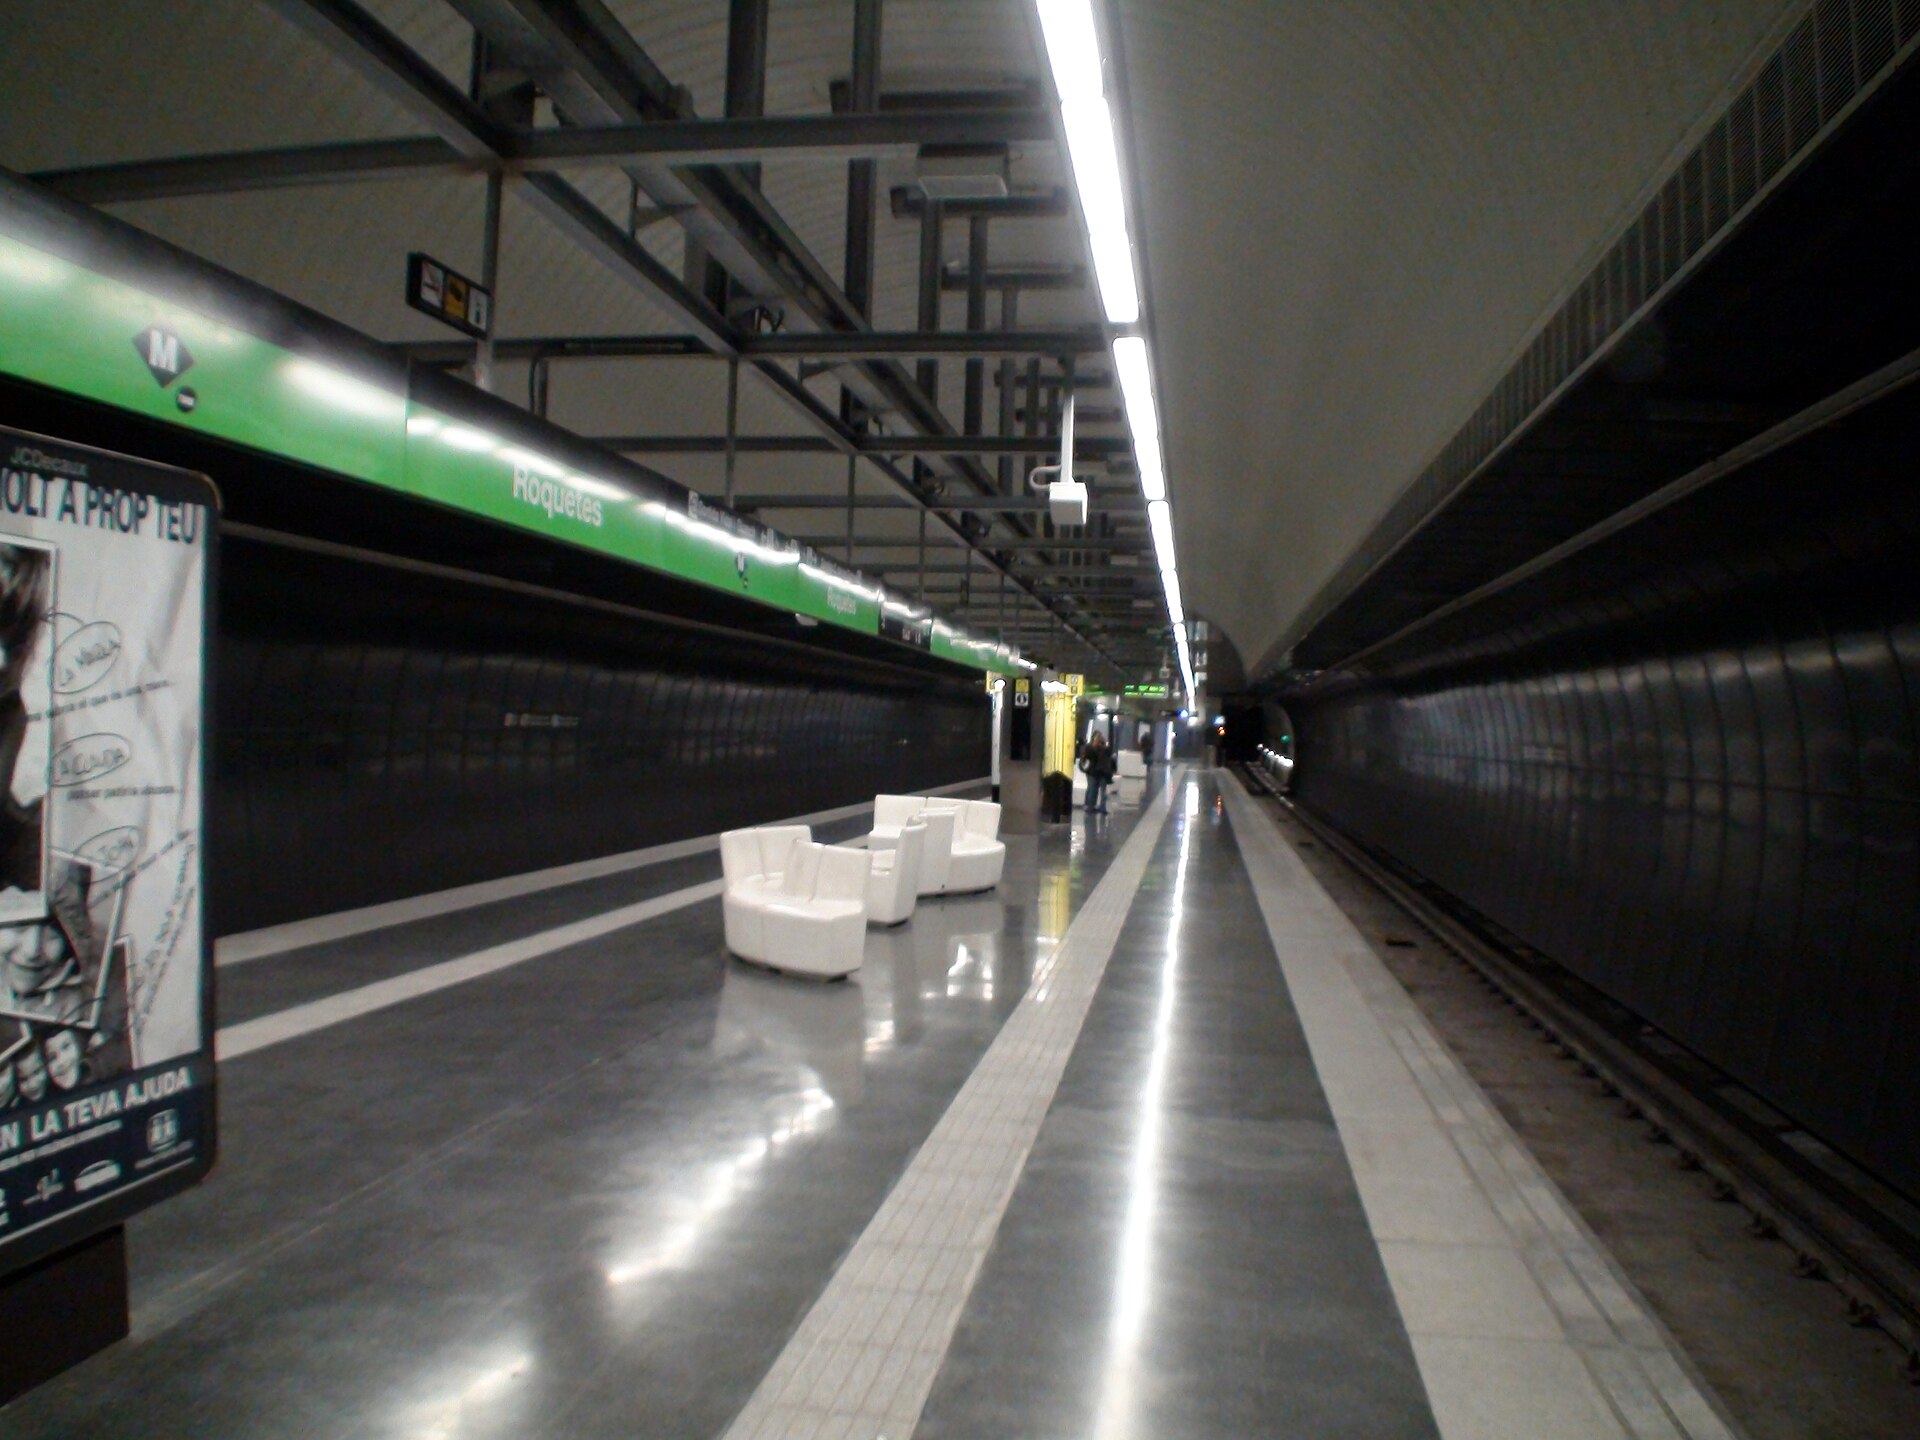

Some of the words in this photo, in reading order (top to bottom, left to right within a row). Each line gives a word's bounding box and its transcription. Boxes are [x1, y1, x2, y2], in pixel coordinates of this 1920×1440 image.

[0, 469, 47, 518] OLT
[513, 463, 602, 528] Roquetes
[30, 1109, 62, 1141] LA
[63, 1089, 120, 1129] TEVA
[124, 1066, 192, 1110] AJUDA
